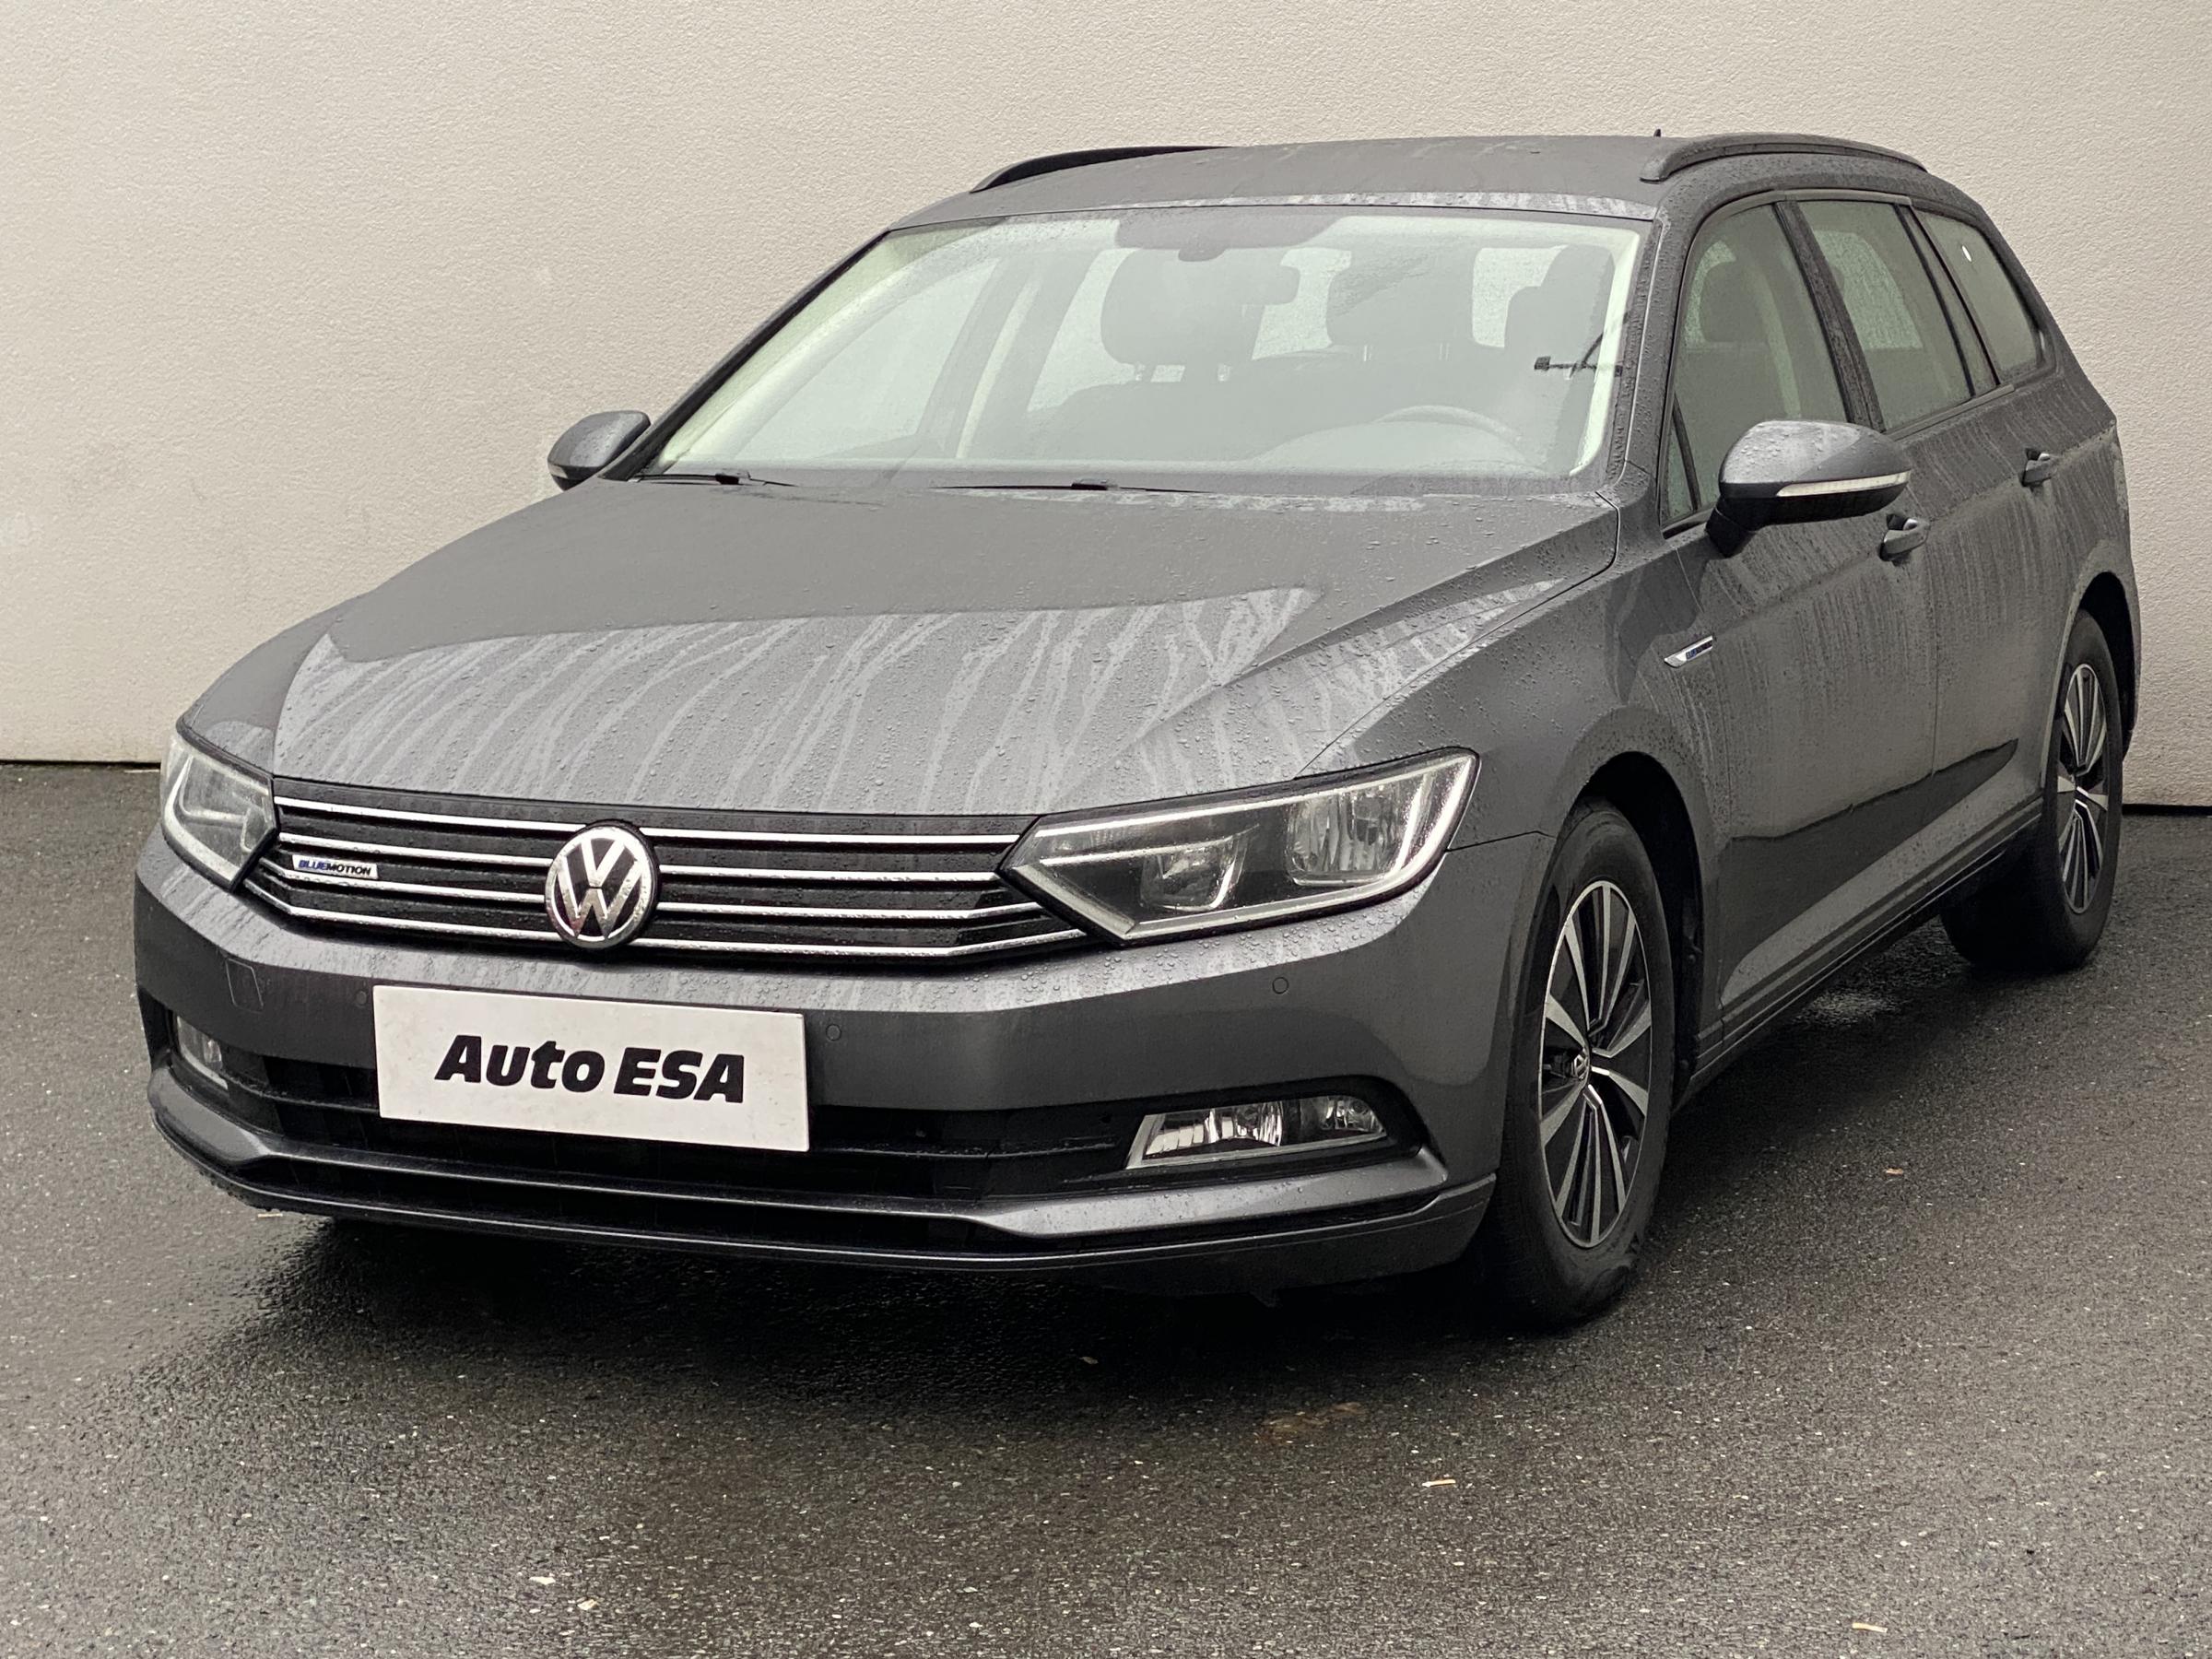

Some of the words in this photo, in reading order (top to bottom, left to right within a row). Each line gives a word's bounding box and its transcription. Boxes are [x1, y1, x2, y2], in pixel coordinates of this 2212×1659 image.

[298, 859, 372, 876] BLUEMOTION
[434, 1034, 606, 1093] Auto
[613, 1047, 745, 1104] ESA
